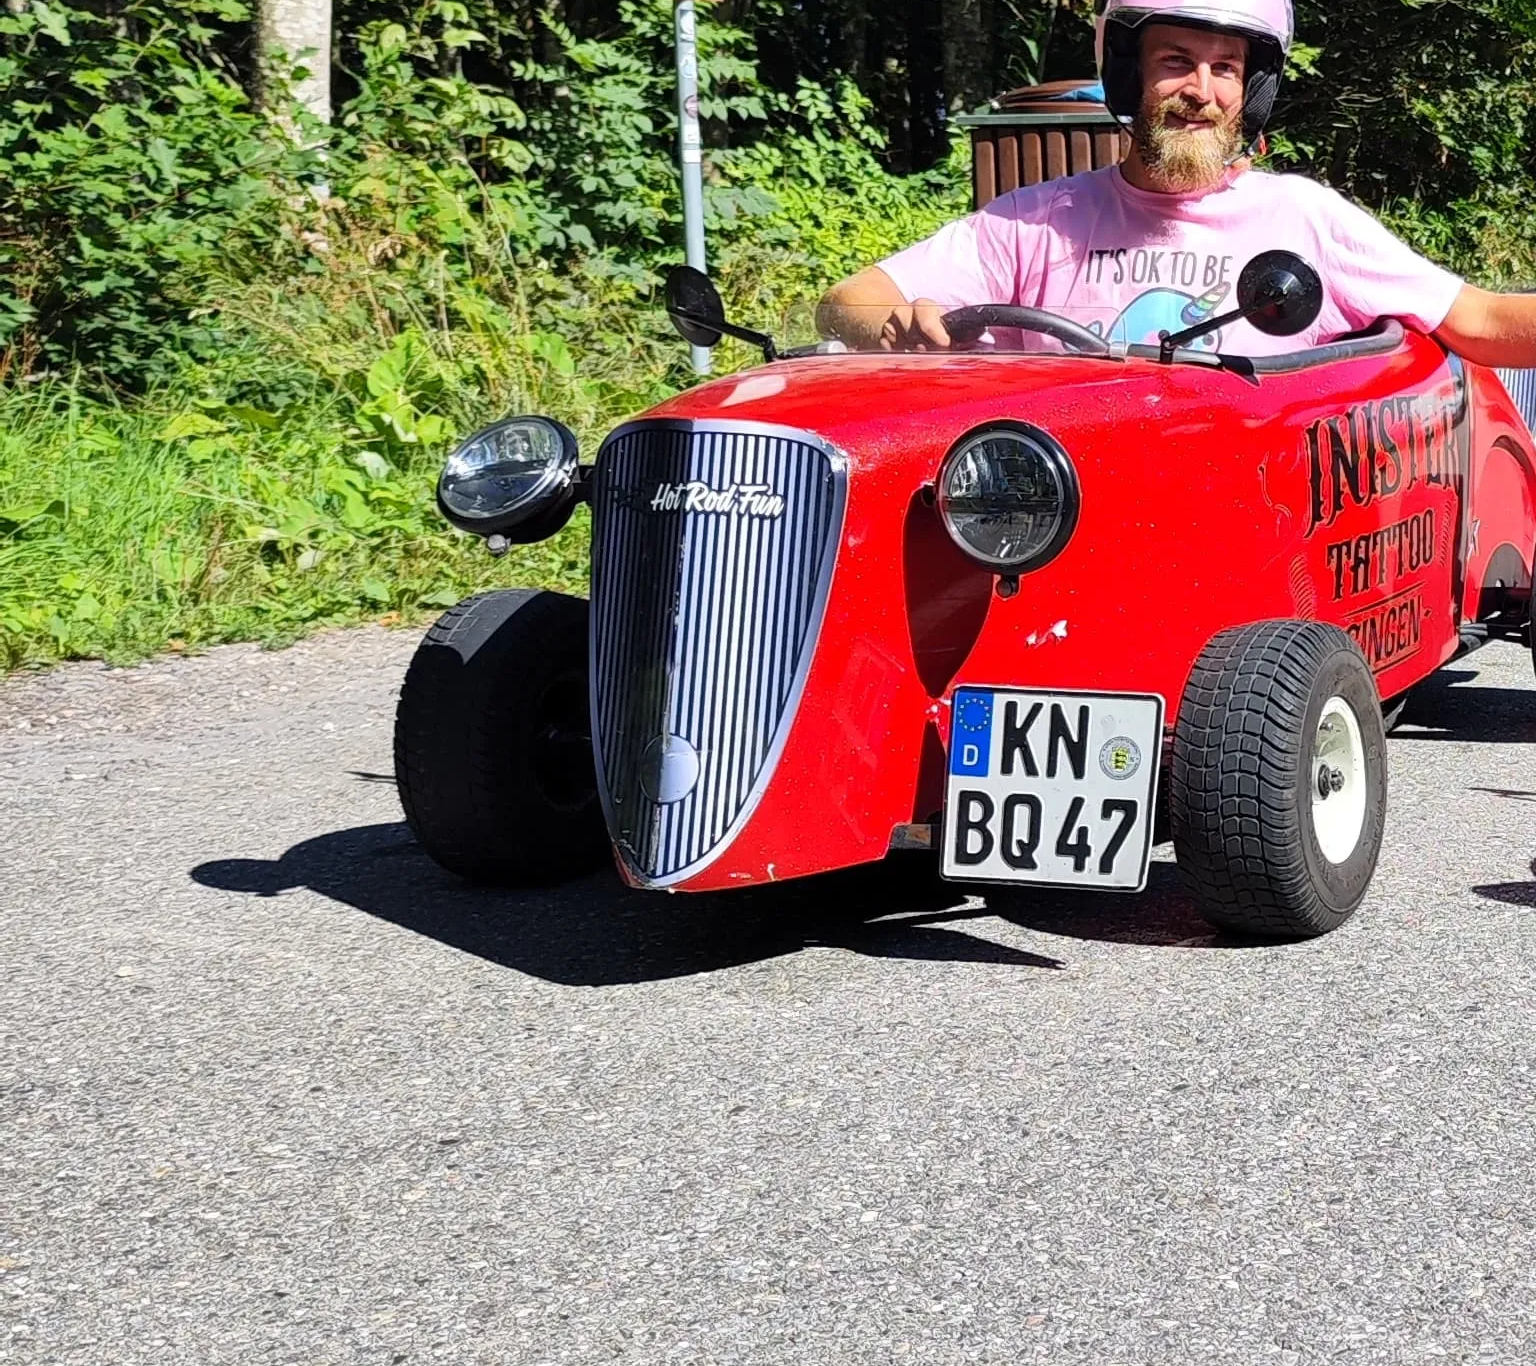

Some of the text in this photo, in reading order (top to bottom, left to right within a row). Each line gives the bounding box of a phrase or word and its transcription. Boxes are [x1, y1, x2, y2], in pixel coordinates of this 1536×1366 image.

[1086, 248, 1233, 287] IT'S OK TO BE
[650, 481, 784, 518] Hot Rod Fun
[1326, 509, 1433, 600] TATTOO
[963, 746, 978, 766] D
[1001, 700, 1090, 780] KN
[954, 790, 1138, 876] BQ 47
